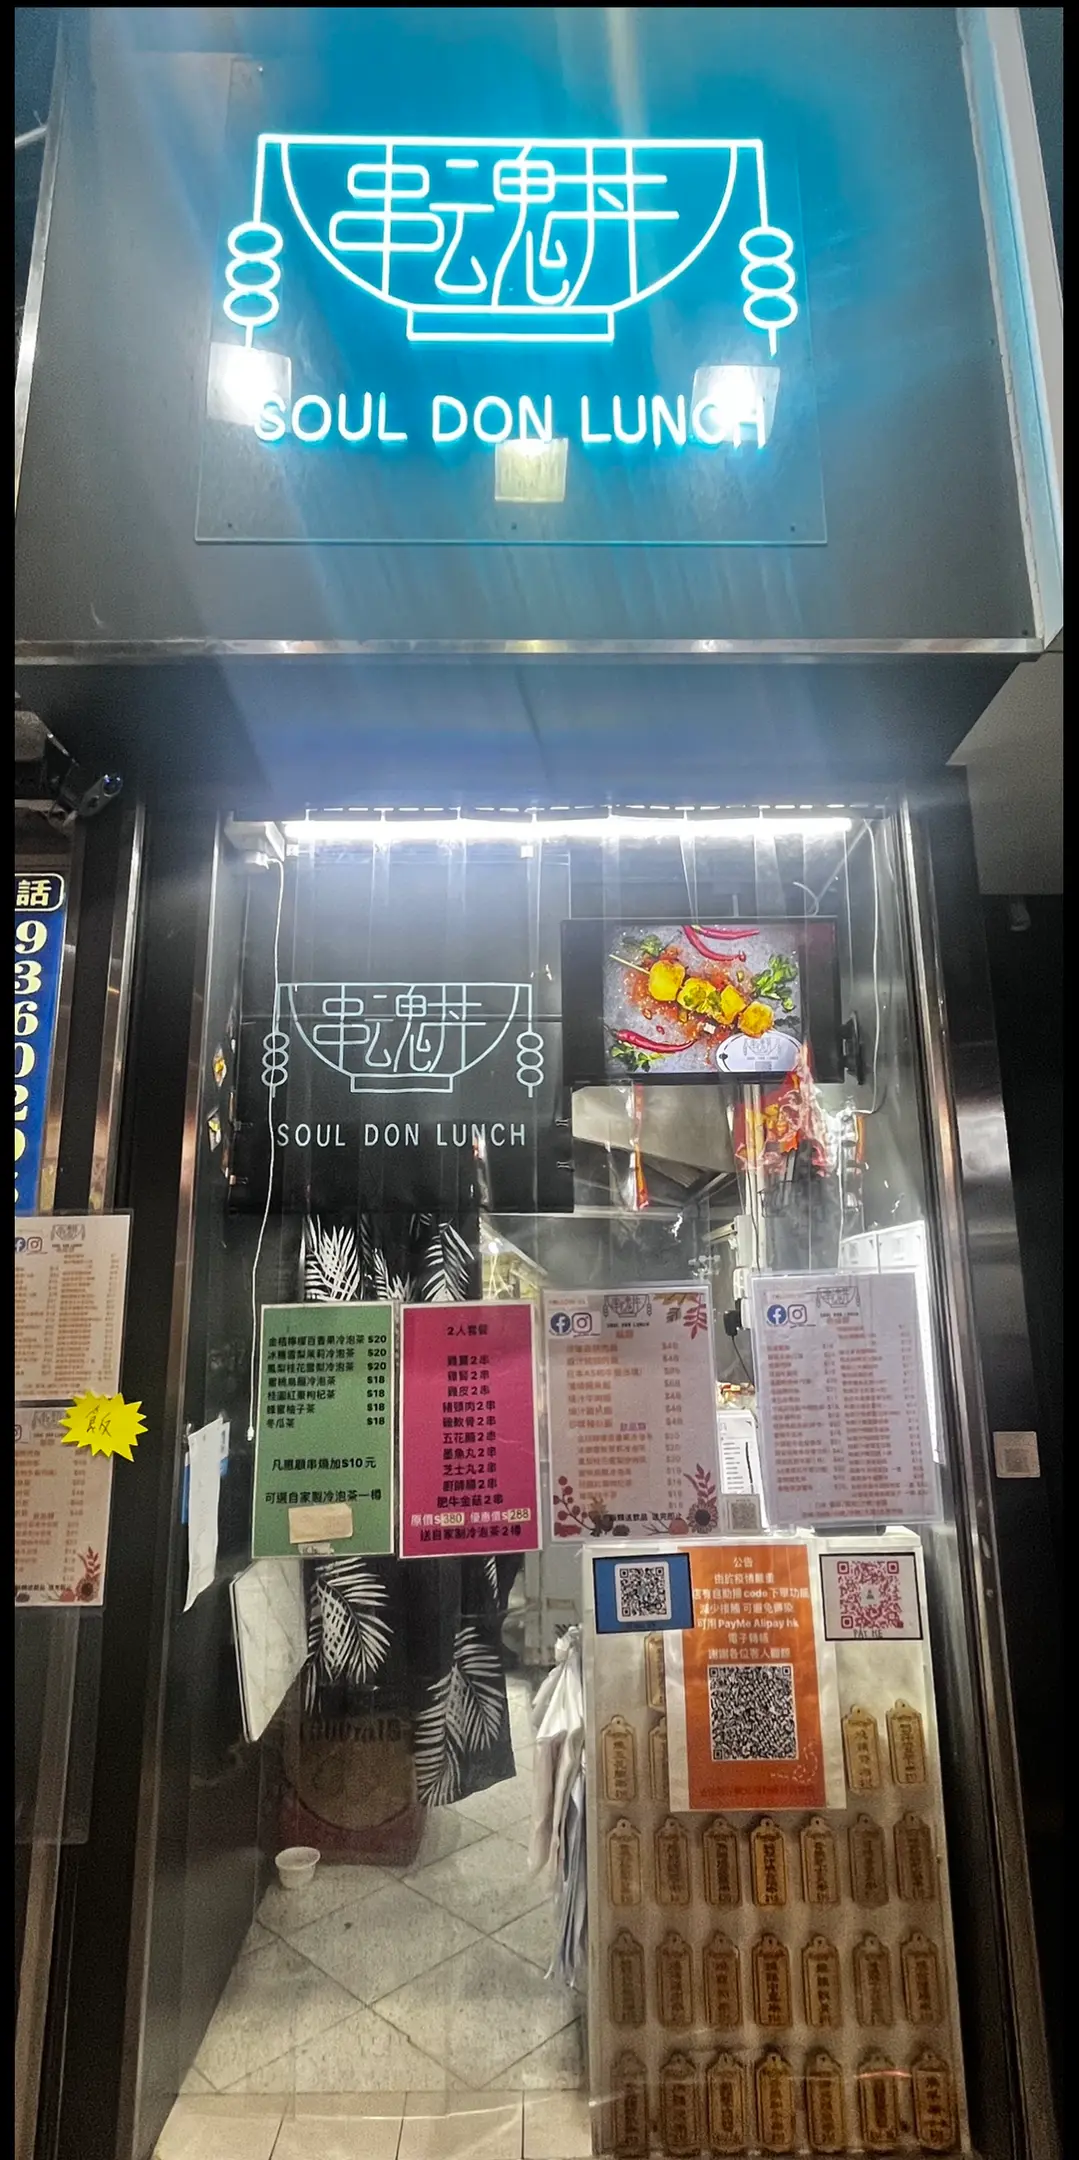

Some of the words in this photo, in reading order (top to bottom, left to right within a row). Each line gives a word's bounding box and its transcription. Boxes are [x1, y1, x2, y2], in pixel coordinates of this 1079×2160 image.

[253, 392, 408, 443] SOUL
[432, 394, 553, 444] DON
[580, 394, 767, 449] LUNCH
[276, 1123, 346, 1147] SOUL
[364, 1123, 420, 1147] DON
[436, 1123, 526, 1147] LUNCH
[447, 1324, 488, 1336] 2人套餐
[367, 1335, 387, 1344] $20
[367, 1348, 387, 1357] $20
[367, 1362, 387, 1371] $20
[366, 1376, 385, 1384] $18
[366, 1389, 385, 1398] $18
[366, 1403, 385, 1412] $18
[85, 1405, 113, 1437] 飯
[266, 1418, 295, 1429] 冬瓜茶
[366, 1417, 385, 1426] $18
[442, 1446, 497, 1460] 墨魚丸2串
[442, 1462, 497, 1476] 芝士丸2串
[733, 1557, 753, 1568] 公告
[718, 1618, 752, 1630] PayMe
[753, 1618, 785, 1630] Alipay
[786, 1618, 799, 1628] hk
